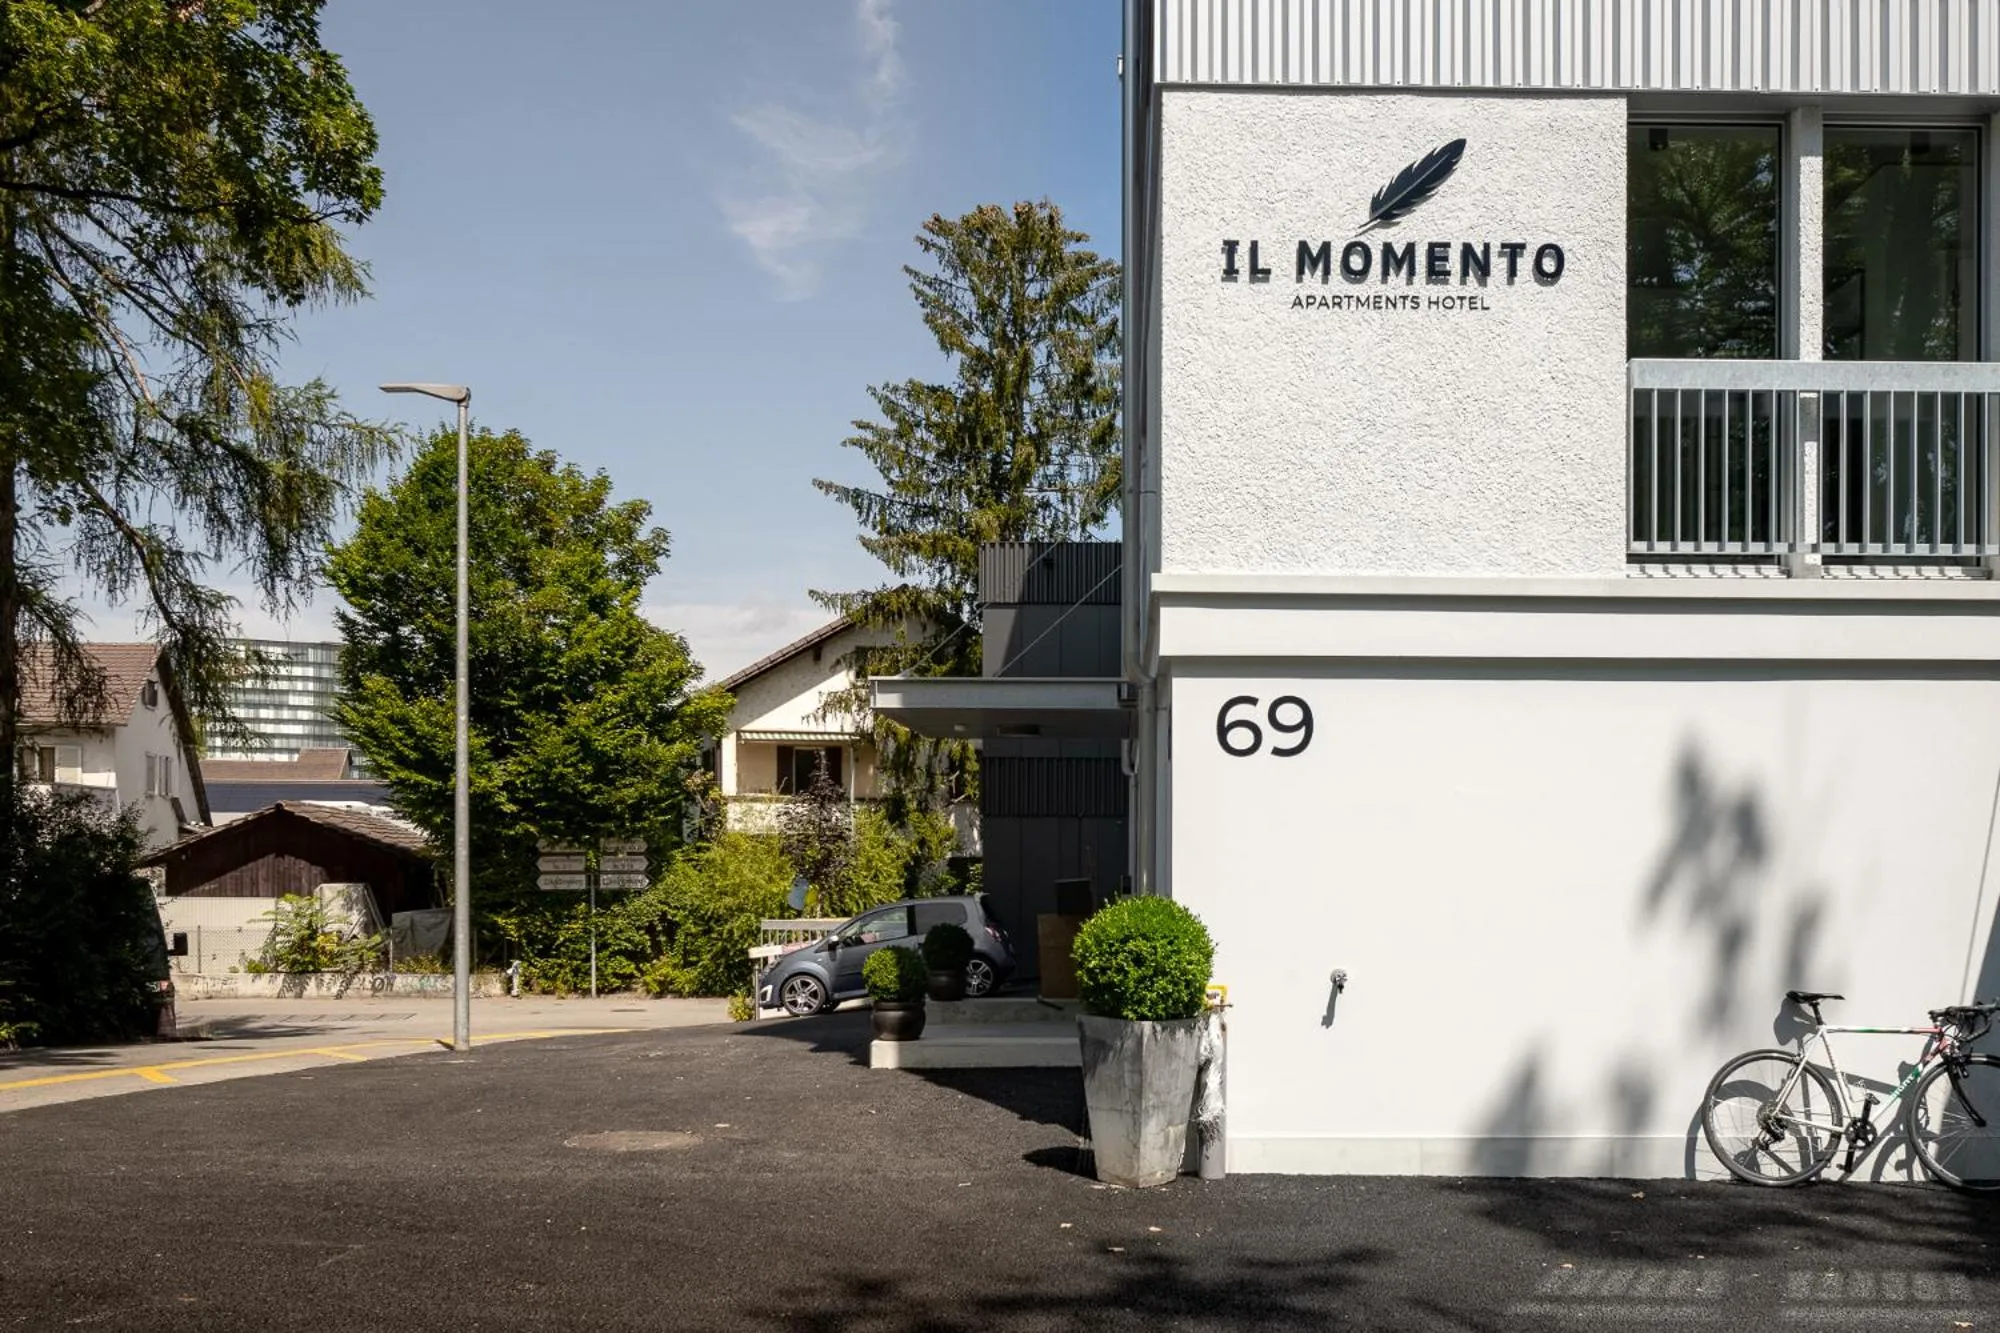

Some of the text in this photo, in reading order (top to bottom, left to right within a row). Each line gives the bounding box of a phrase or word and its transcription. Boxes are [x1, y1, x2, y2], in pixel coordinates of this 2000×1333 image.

[1222, 239, 1565, 281] IL MOMENTO
[1290, 294, 1490, 311] APARTMENTS HOTEL
[1216, 695, 1314, 758] 69
